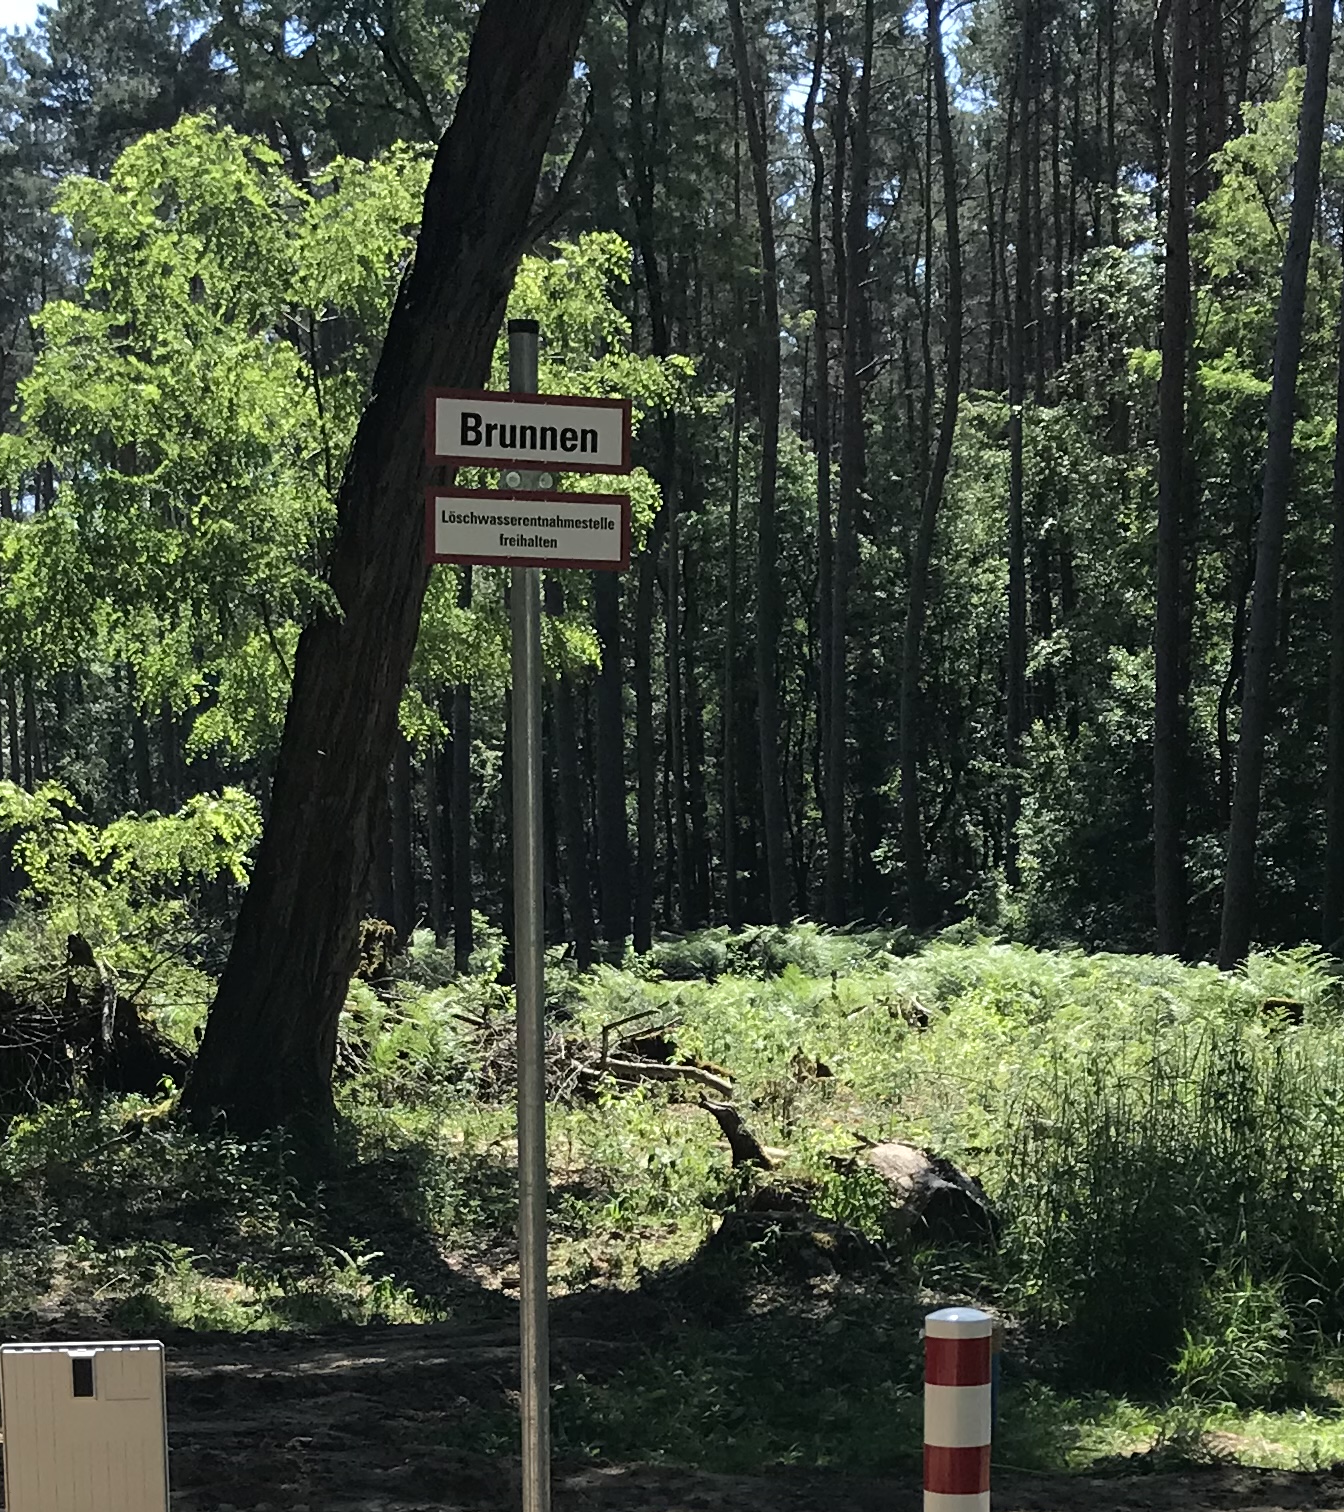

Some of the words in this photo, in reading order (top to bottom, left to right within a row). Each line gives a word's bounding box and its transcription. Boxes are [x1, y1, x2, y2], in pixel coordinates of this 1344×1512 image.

[460, 411, 598, 453] Brunnen
[441, 510, 615, 530] Löschwasserentnahmestelle
[499, 533, 558, 549] freihalten
